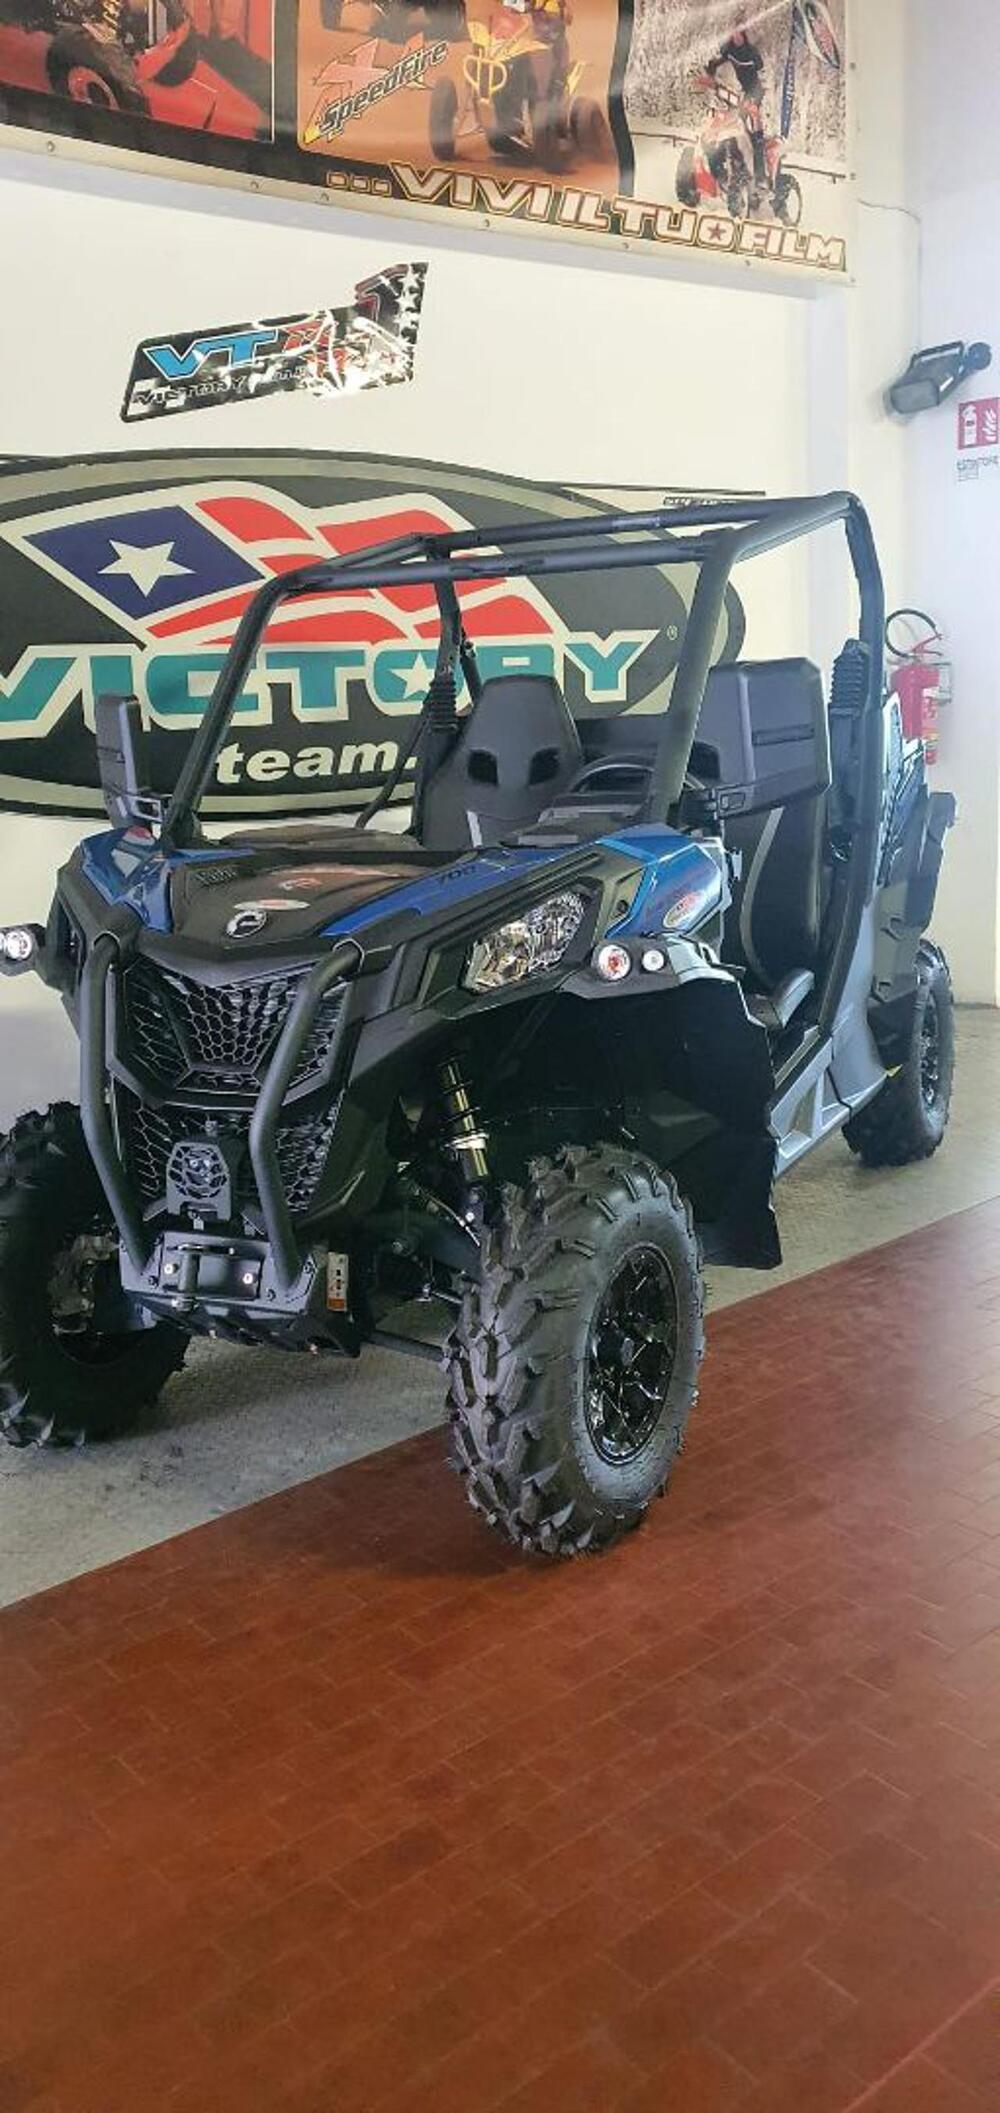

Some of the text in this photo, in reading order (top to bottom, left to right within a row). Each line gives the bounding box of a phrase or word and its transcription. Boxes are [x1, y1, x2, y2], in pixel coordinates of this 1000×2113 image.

[319, 39, 449, 142] SpeedFire
[556, 186, 610, 232] IL
[611, 196, 737, 251] TUO
[738, 219, 846, 271] FILM
